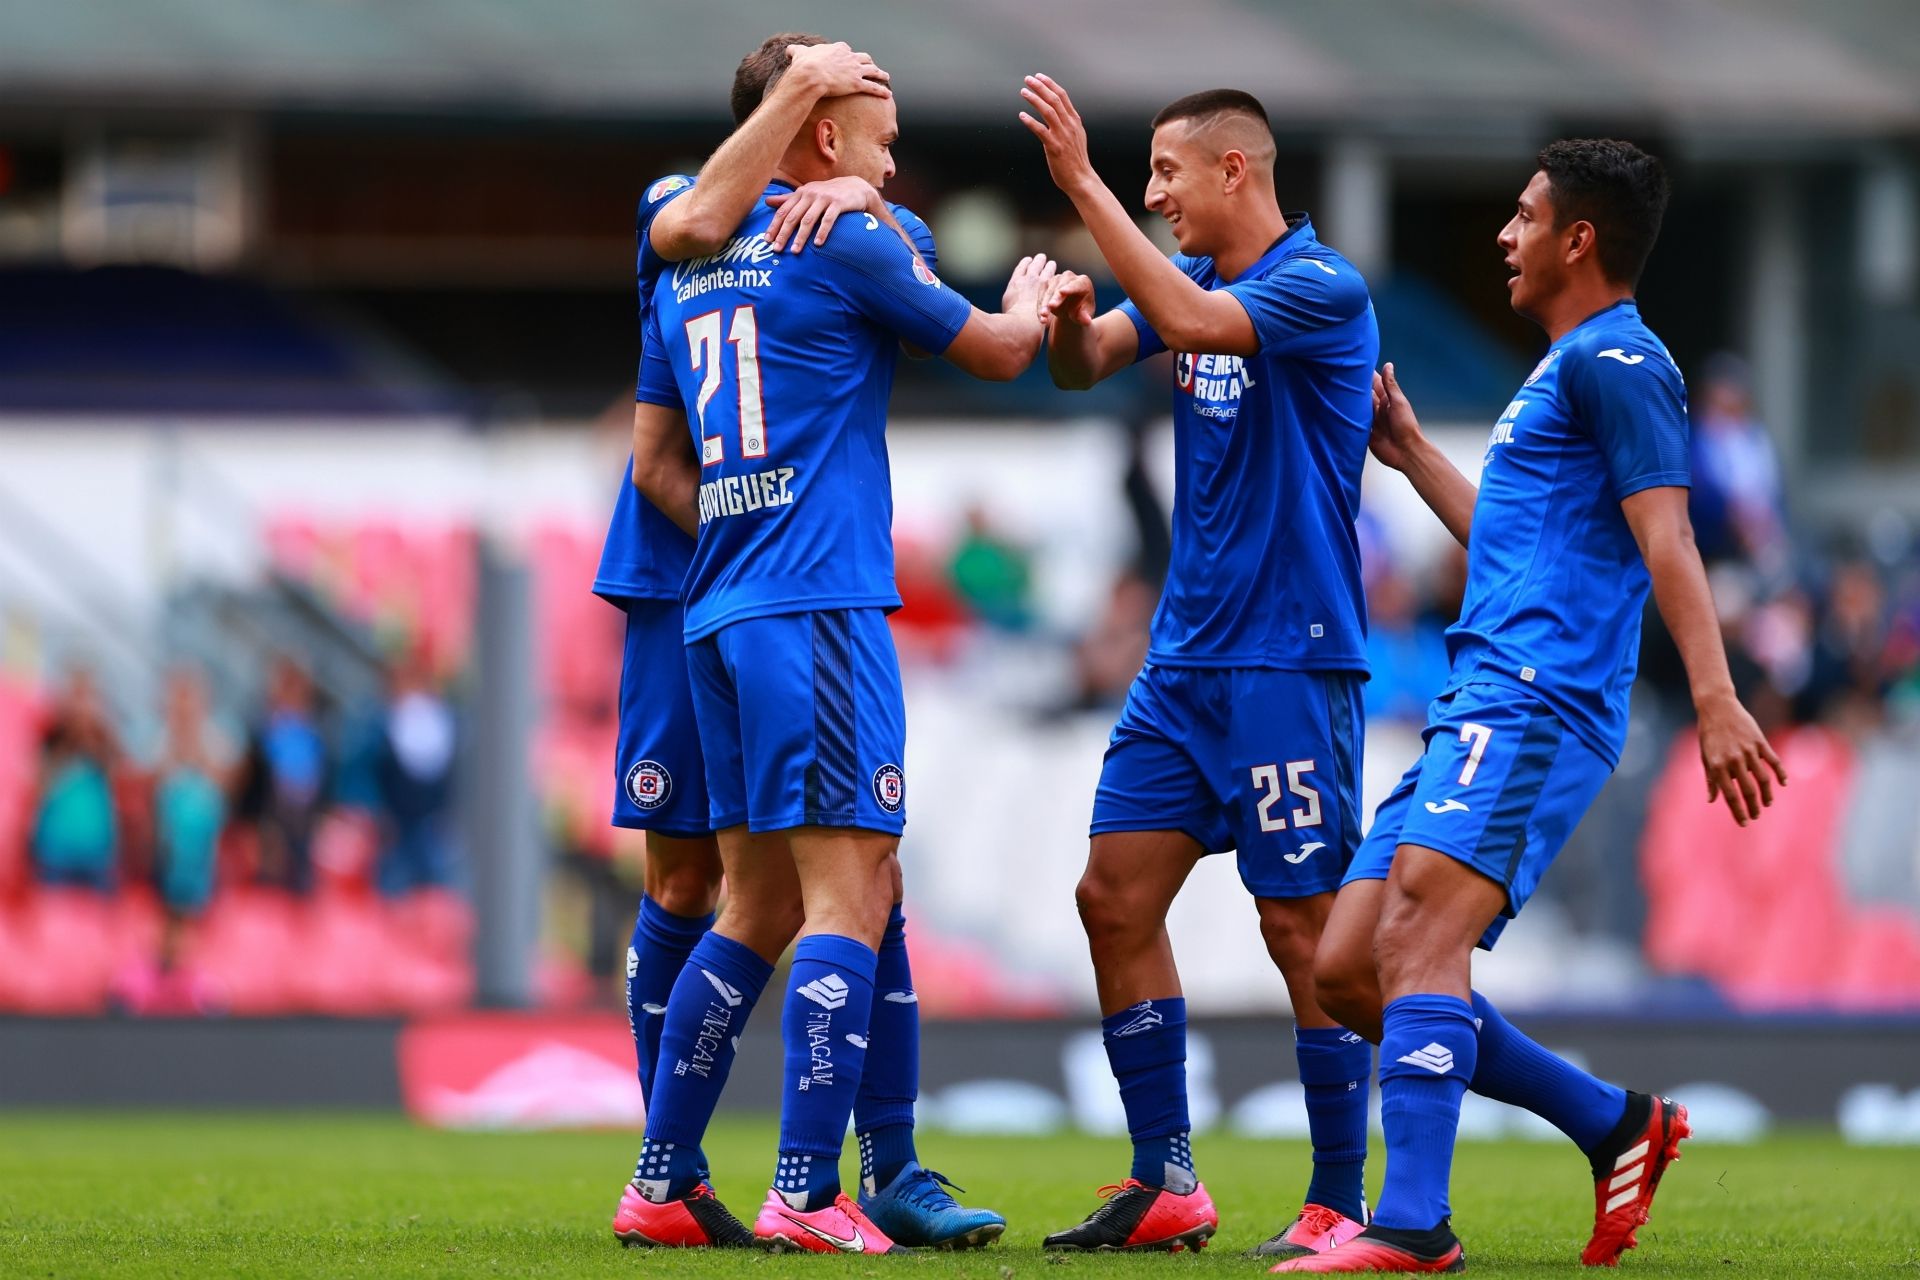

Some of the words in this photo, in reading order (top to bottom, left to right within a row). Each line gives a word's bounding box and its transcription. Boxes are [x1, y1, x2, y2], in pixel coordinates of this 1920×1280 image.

[677, 267, 772, 304] caliente.mx
[685, 304, 768, 467] 21
[1194, 377, 1228, 401] RUZ
[1457, 722, 1493, 787] 7
[1250, 759, 1322, 833] 25
[806, 1013, 833, 1085] FINAGAM
